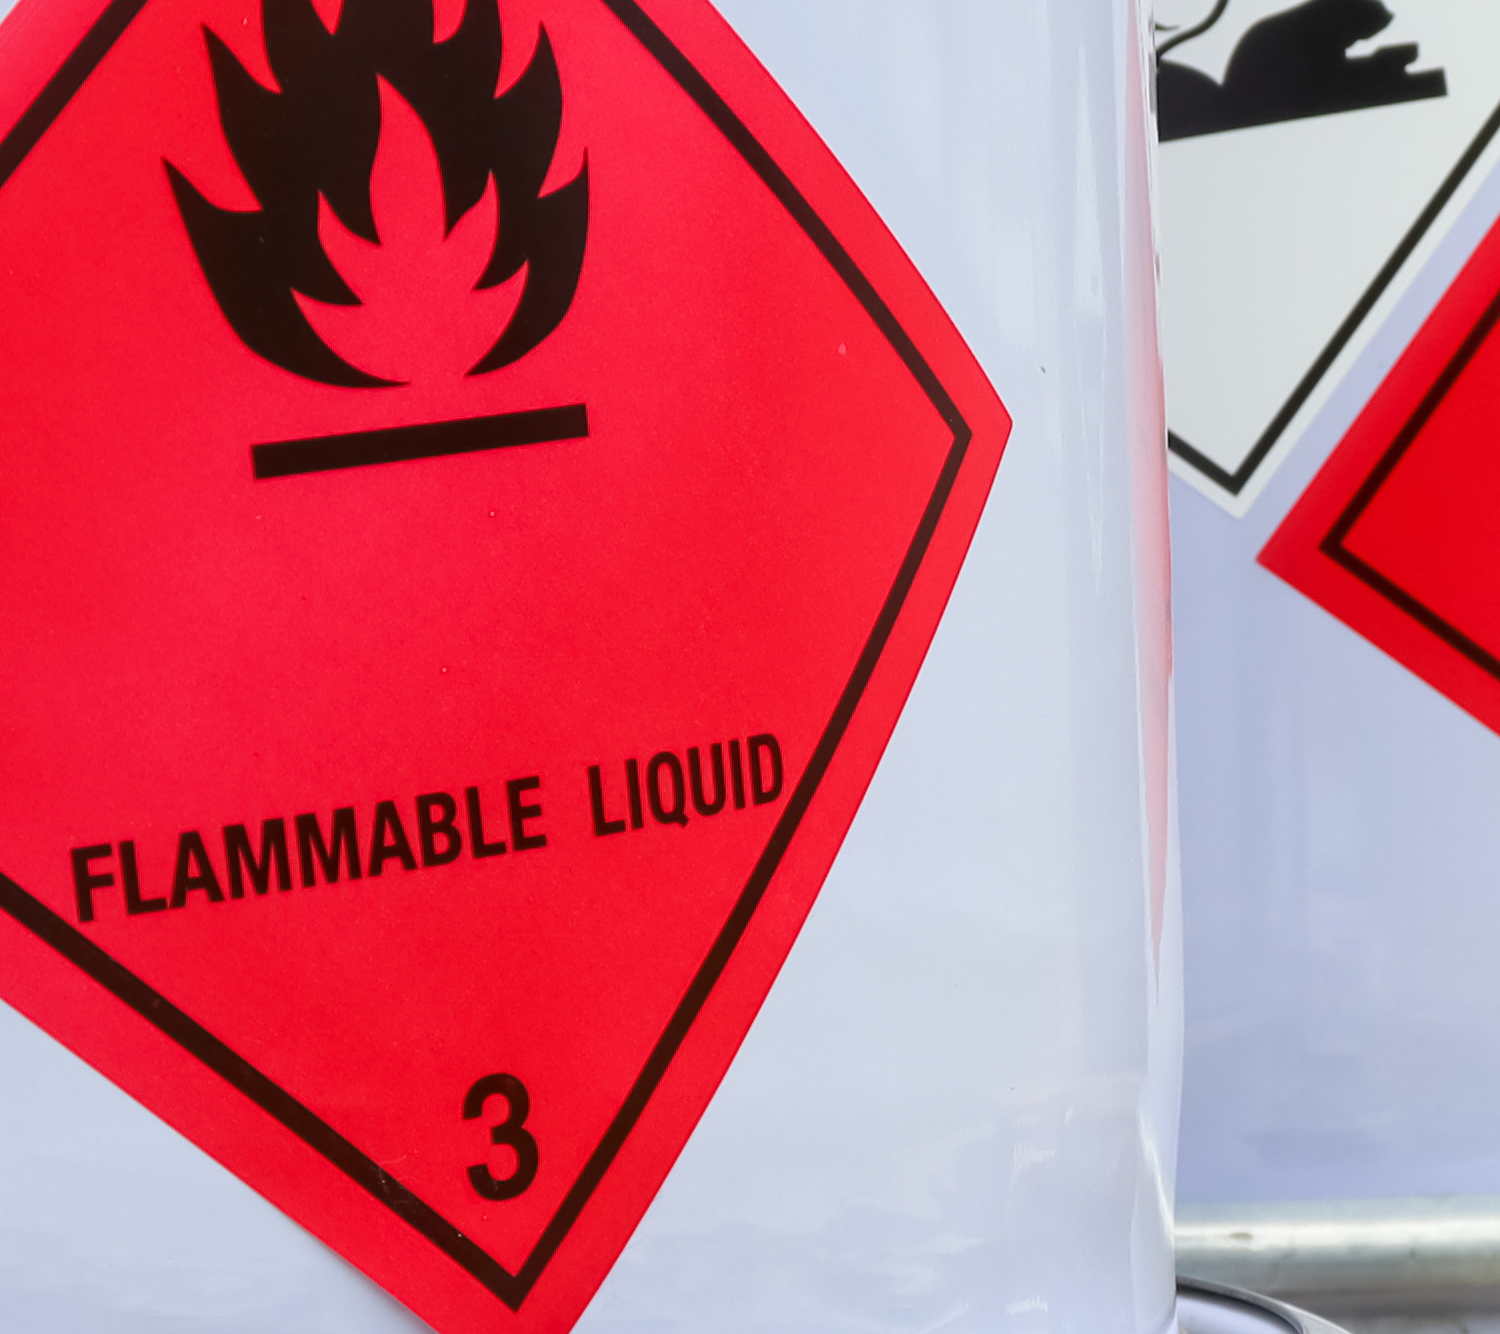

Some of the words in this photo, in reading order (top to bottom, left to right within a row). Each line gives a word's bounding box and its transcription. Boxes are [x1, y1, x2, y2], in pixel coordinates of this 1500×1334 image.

[70, 776, 547, 923] FLAMMABLE
[588, 733, 784, 838] LIQUID
[461, 1072, 540, 1202] 3
